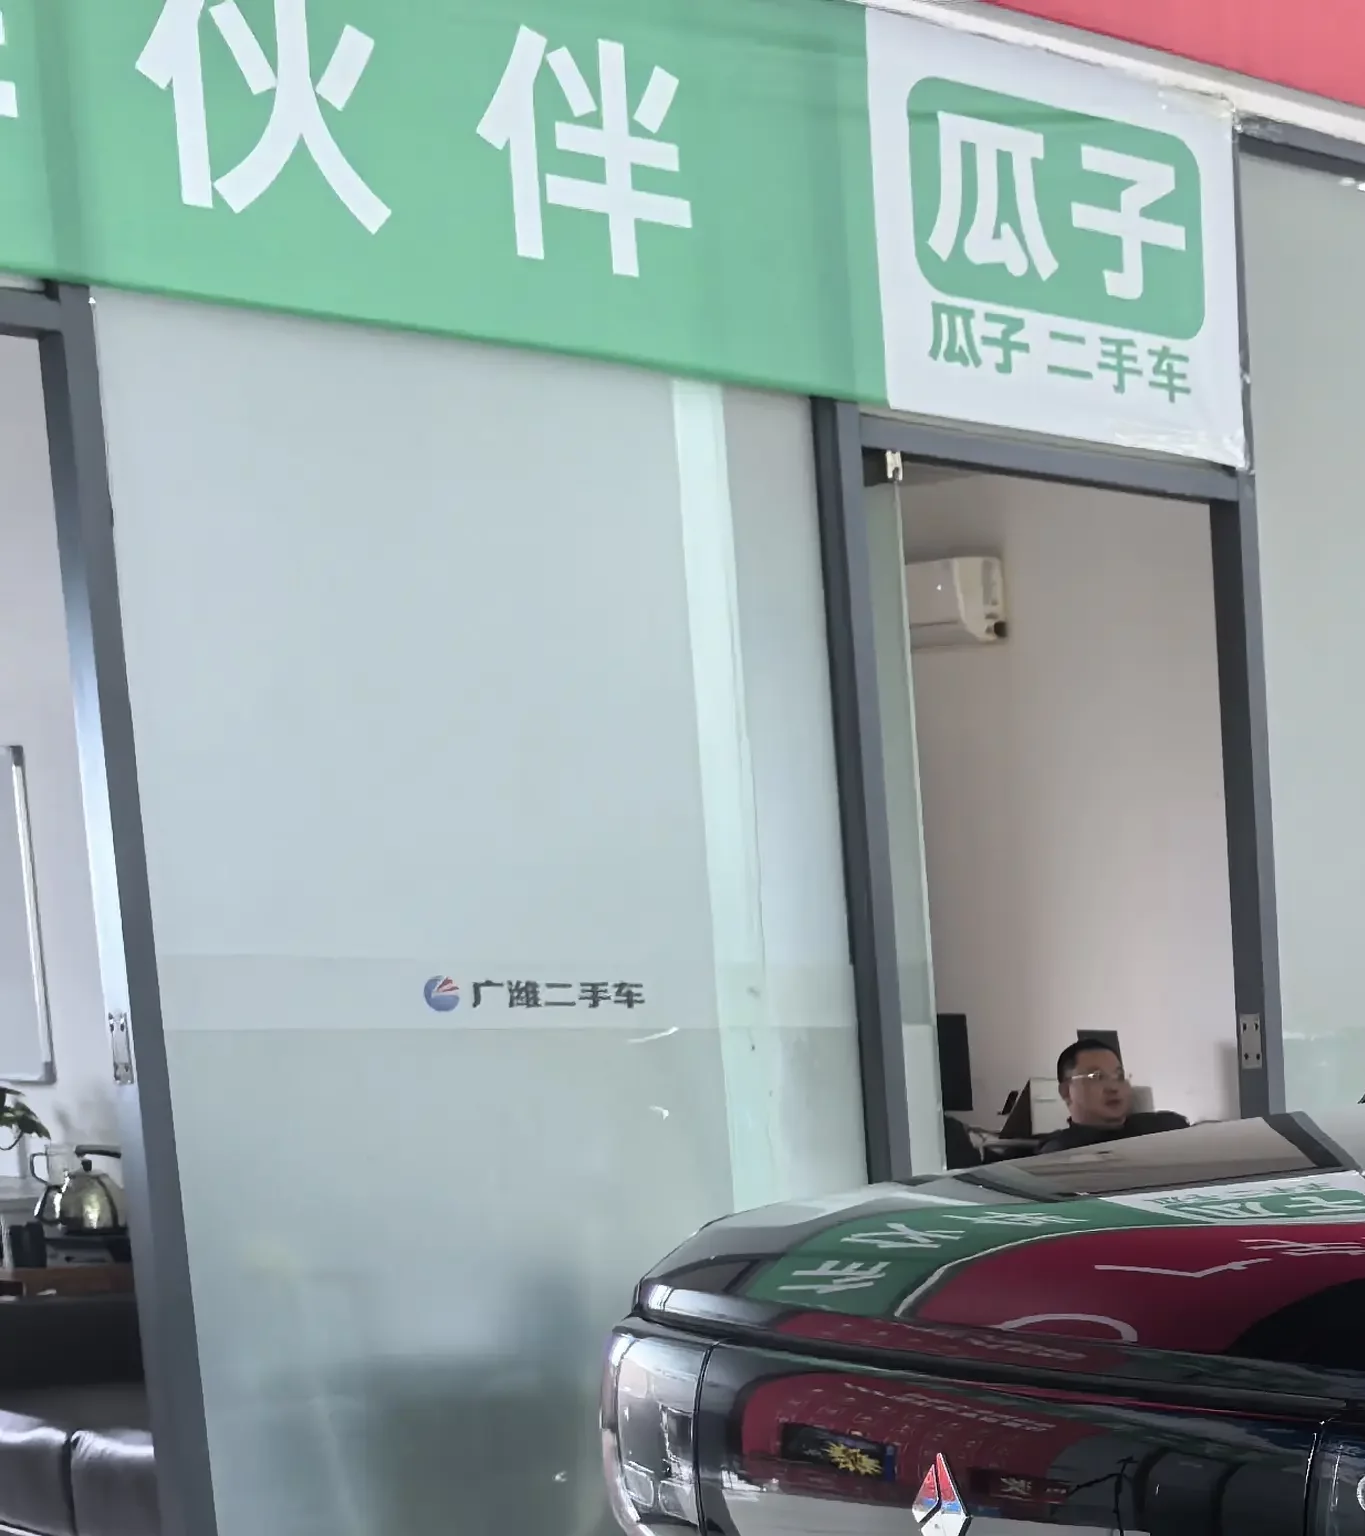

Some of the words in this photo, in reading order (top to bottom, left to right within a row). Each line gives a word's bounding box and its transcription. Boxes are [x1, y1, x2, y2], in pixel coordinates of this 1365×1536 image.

[0, 0, 693, 277] 伙伴
[926, 109, 1187, 301] 瓜子
[472, 979, 645, 1010] 广潍二手车
